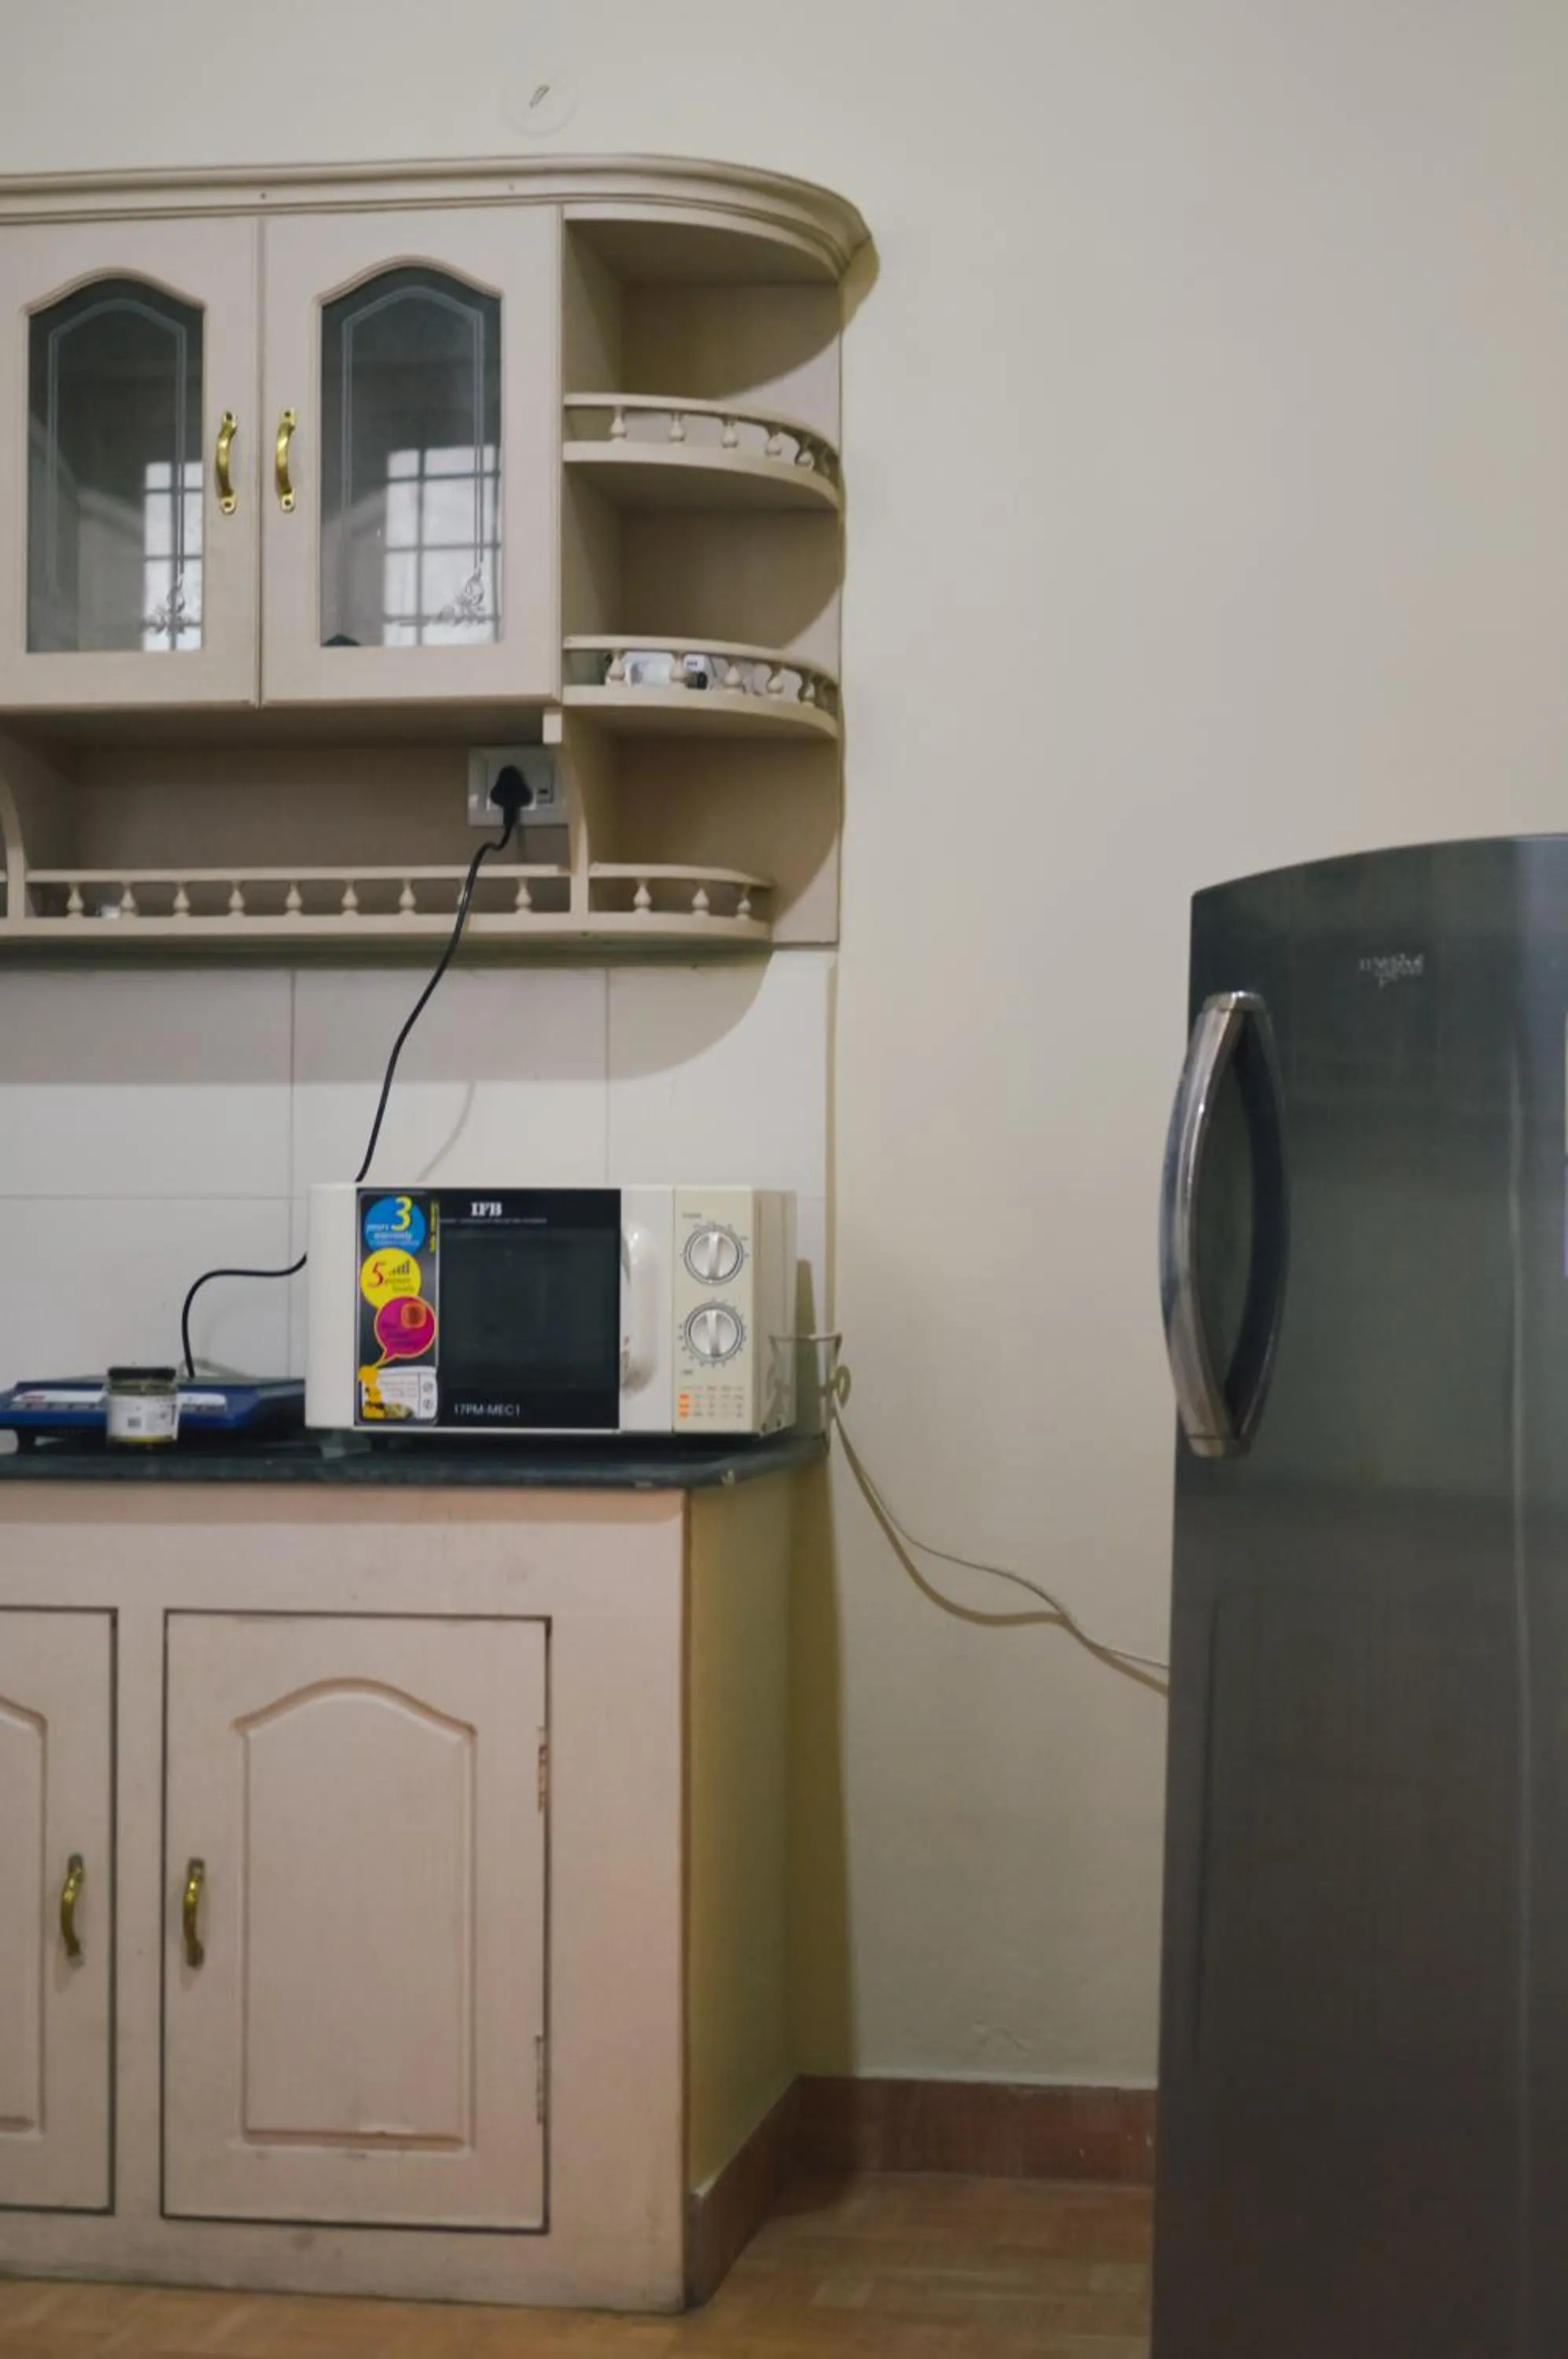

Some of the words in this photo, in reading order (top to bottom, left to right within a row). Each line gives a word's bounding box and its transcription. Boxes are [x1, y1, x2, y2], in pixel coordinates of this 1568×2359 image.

[392, 1196, 412, 1231] 3
[471, 1202, 502, 1217] IFB
[368, 1260, 388, 1289] 5
